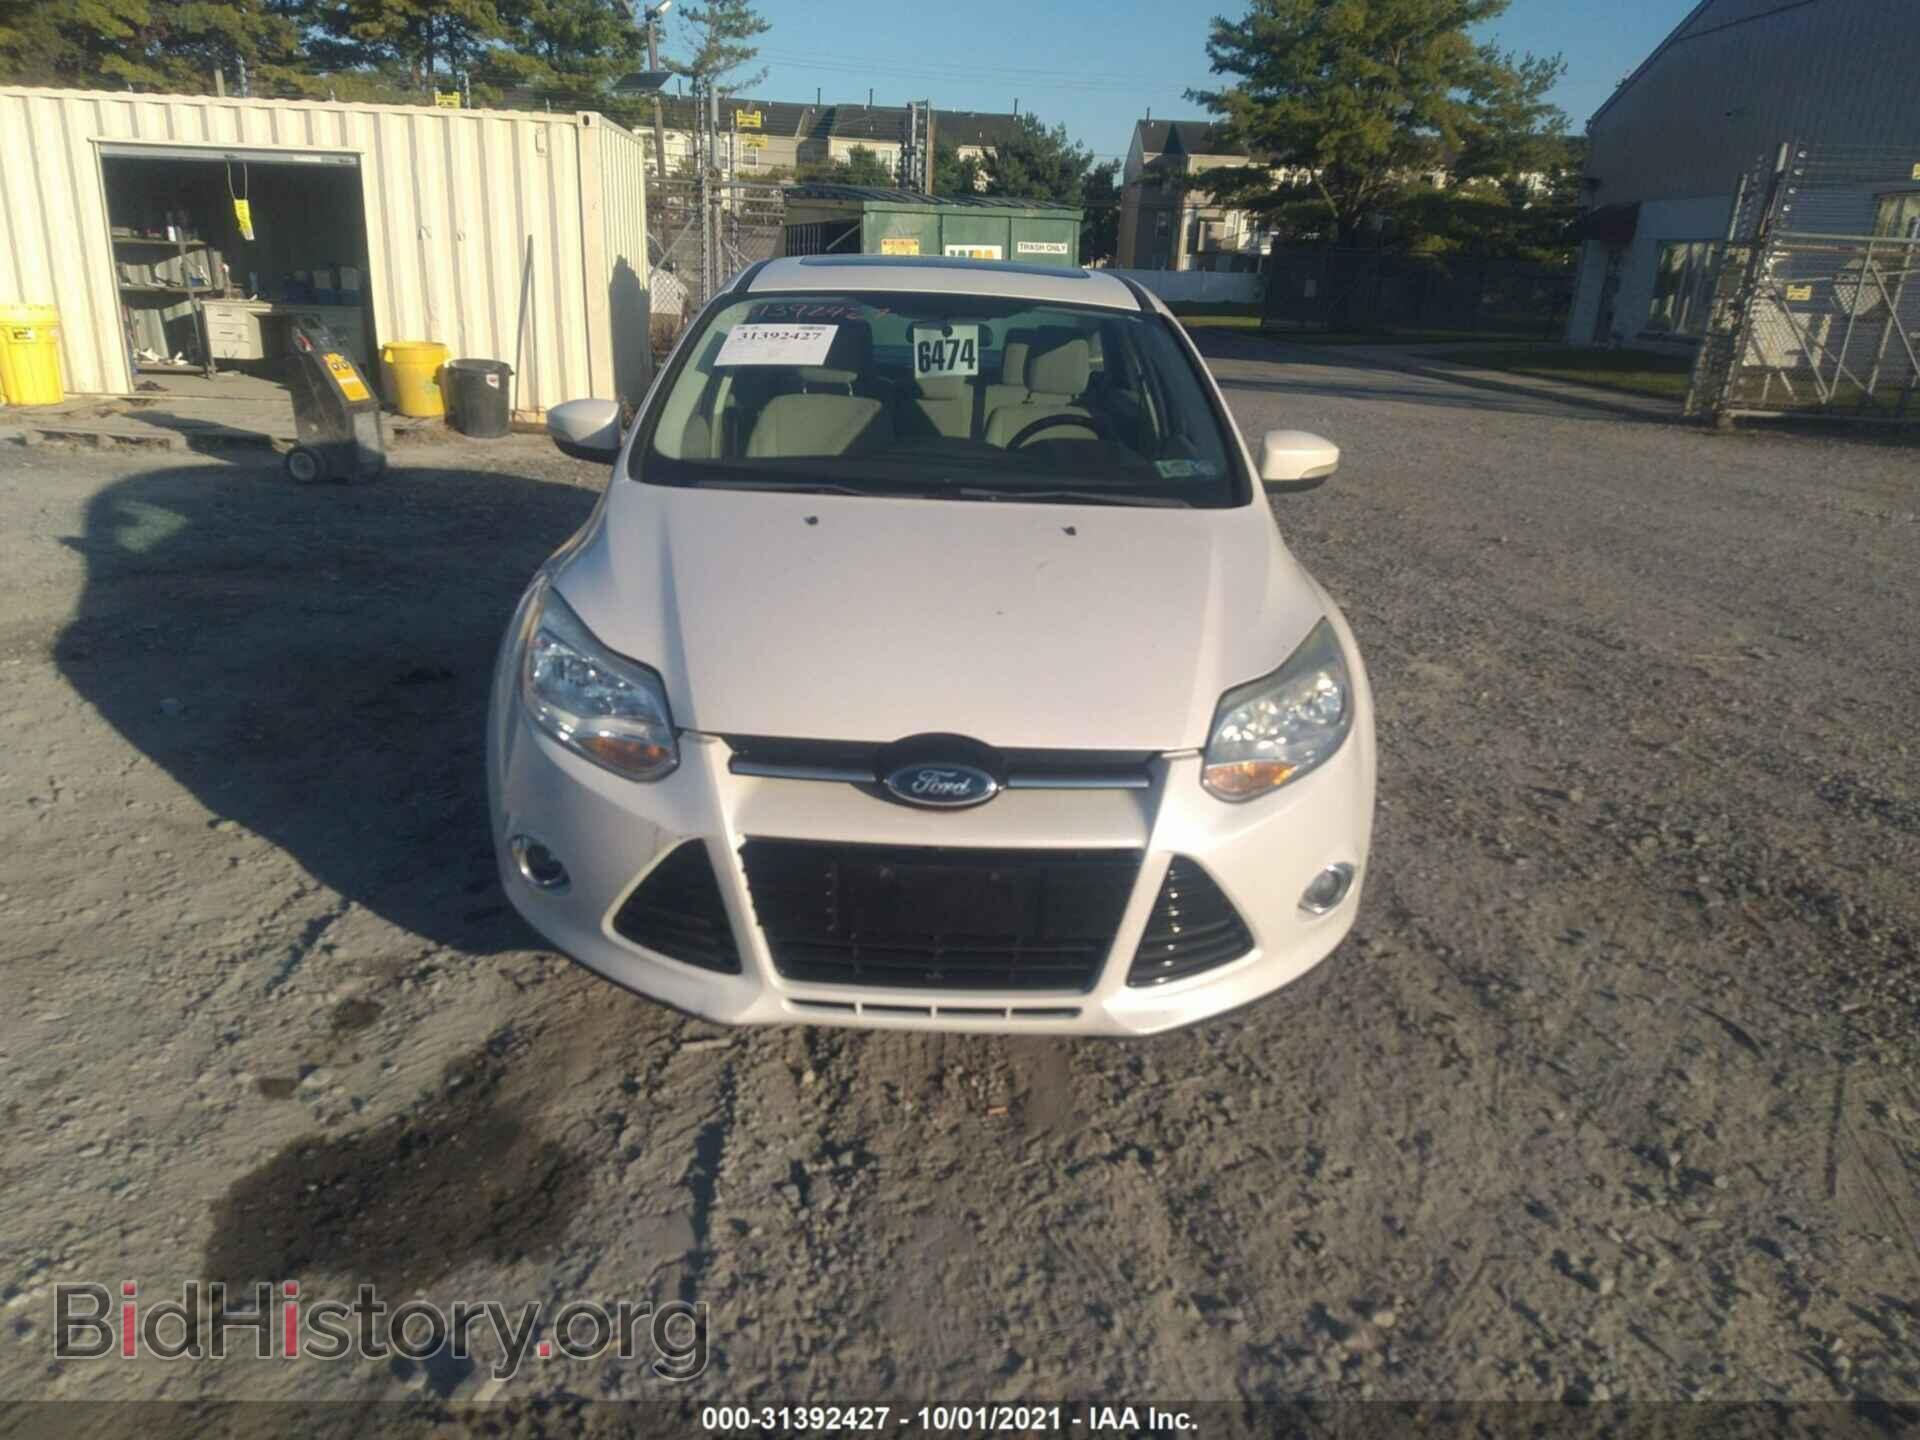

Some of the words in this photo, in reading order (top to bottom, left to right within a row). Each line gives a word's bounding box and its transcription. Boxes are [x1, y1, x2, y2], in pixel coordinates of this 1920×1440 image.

[1019, 243, 1044, 252] TRASH
[1047, 244, 1066, 252] ONLY
[737, 331, 822, 341] 31392427
[918, 339, 976, 373] 6474
[911, 769, 971, 795] Ford
